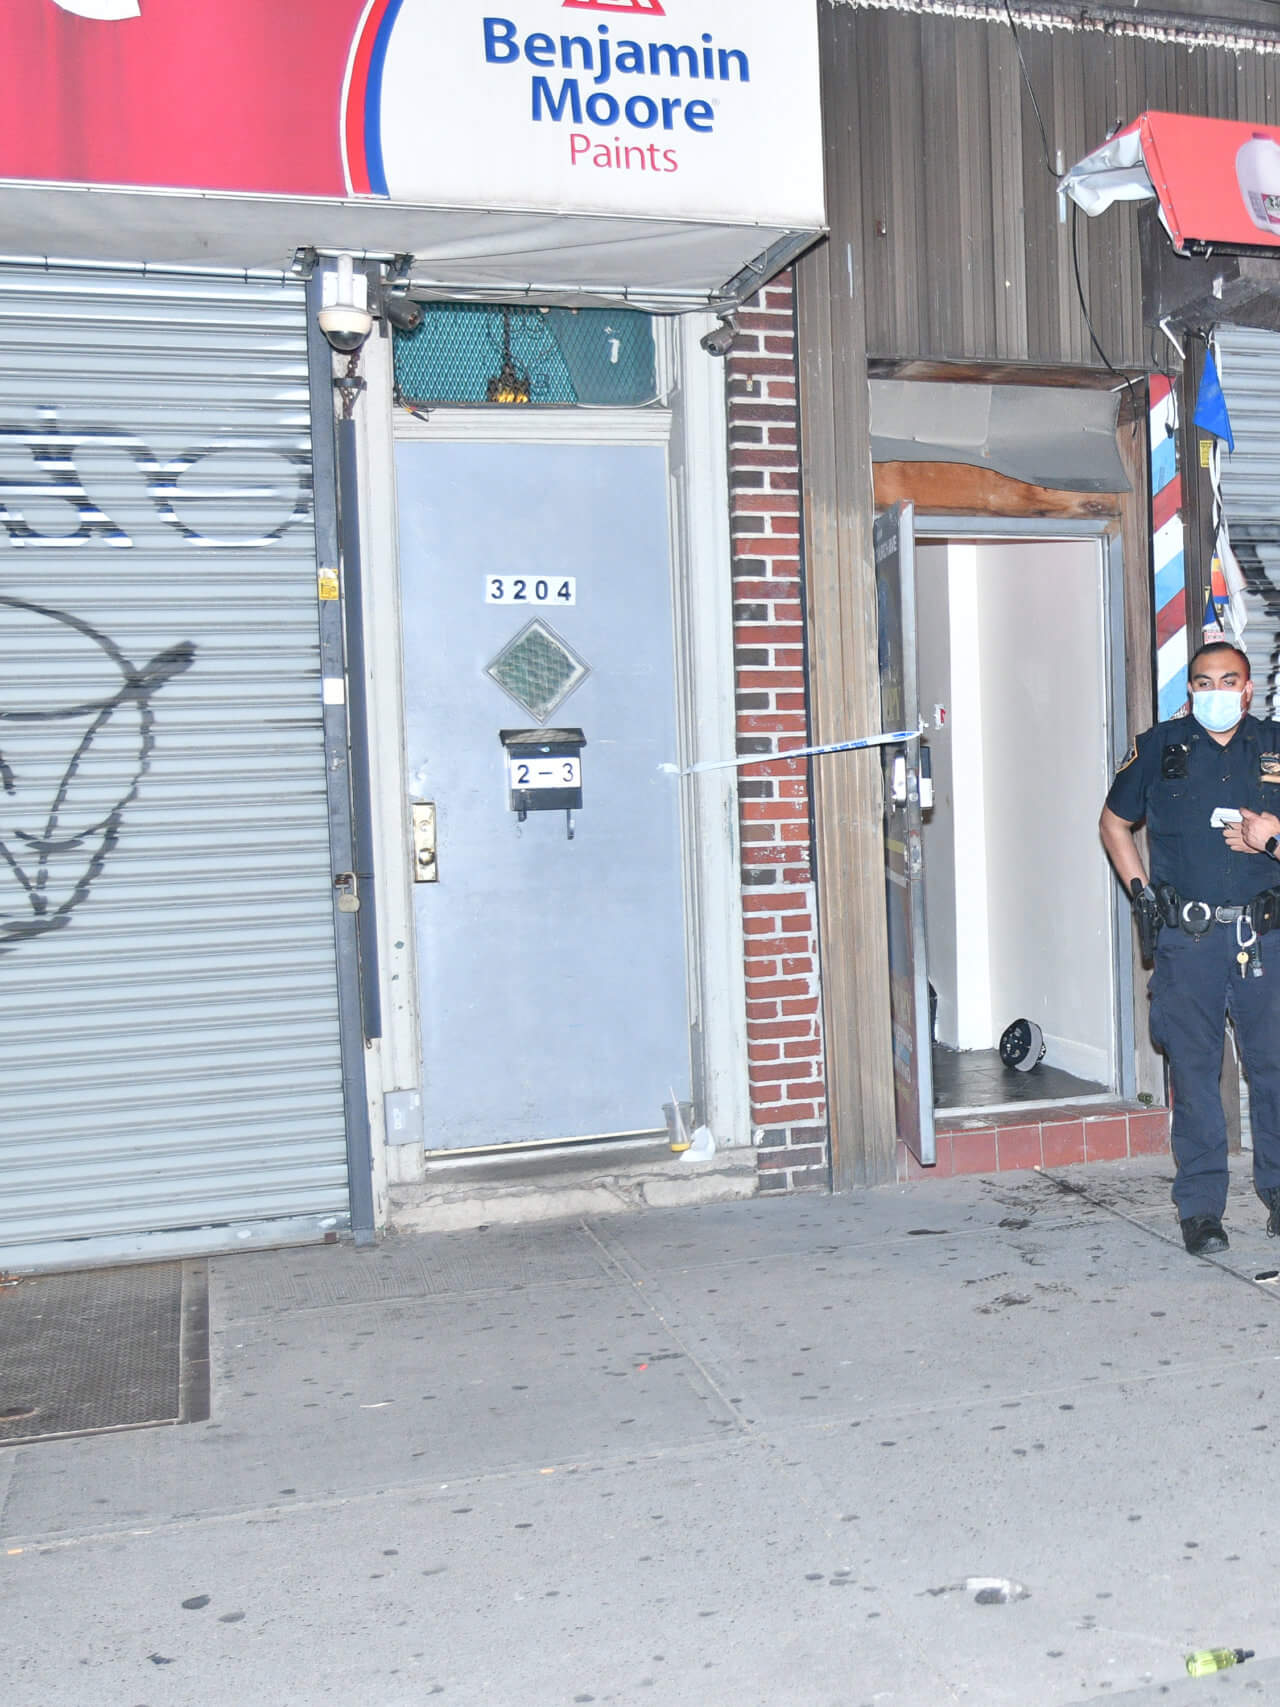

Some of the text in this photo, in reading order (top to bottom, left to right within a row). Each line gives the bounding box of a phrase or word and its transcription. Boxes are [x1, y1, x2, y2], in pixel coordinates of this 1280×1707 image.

[482, 16, 751, 84] Benjamin
[531, 75, 715, 133] Moore
[569, 133, 679, 173] Paints
[490, 578, 572, 602] 3204
